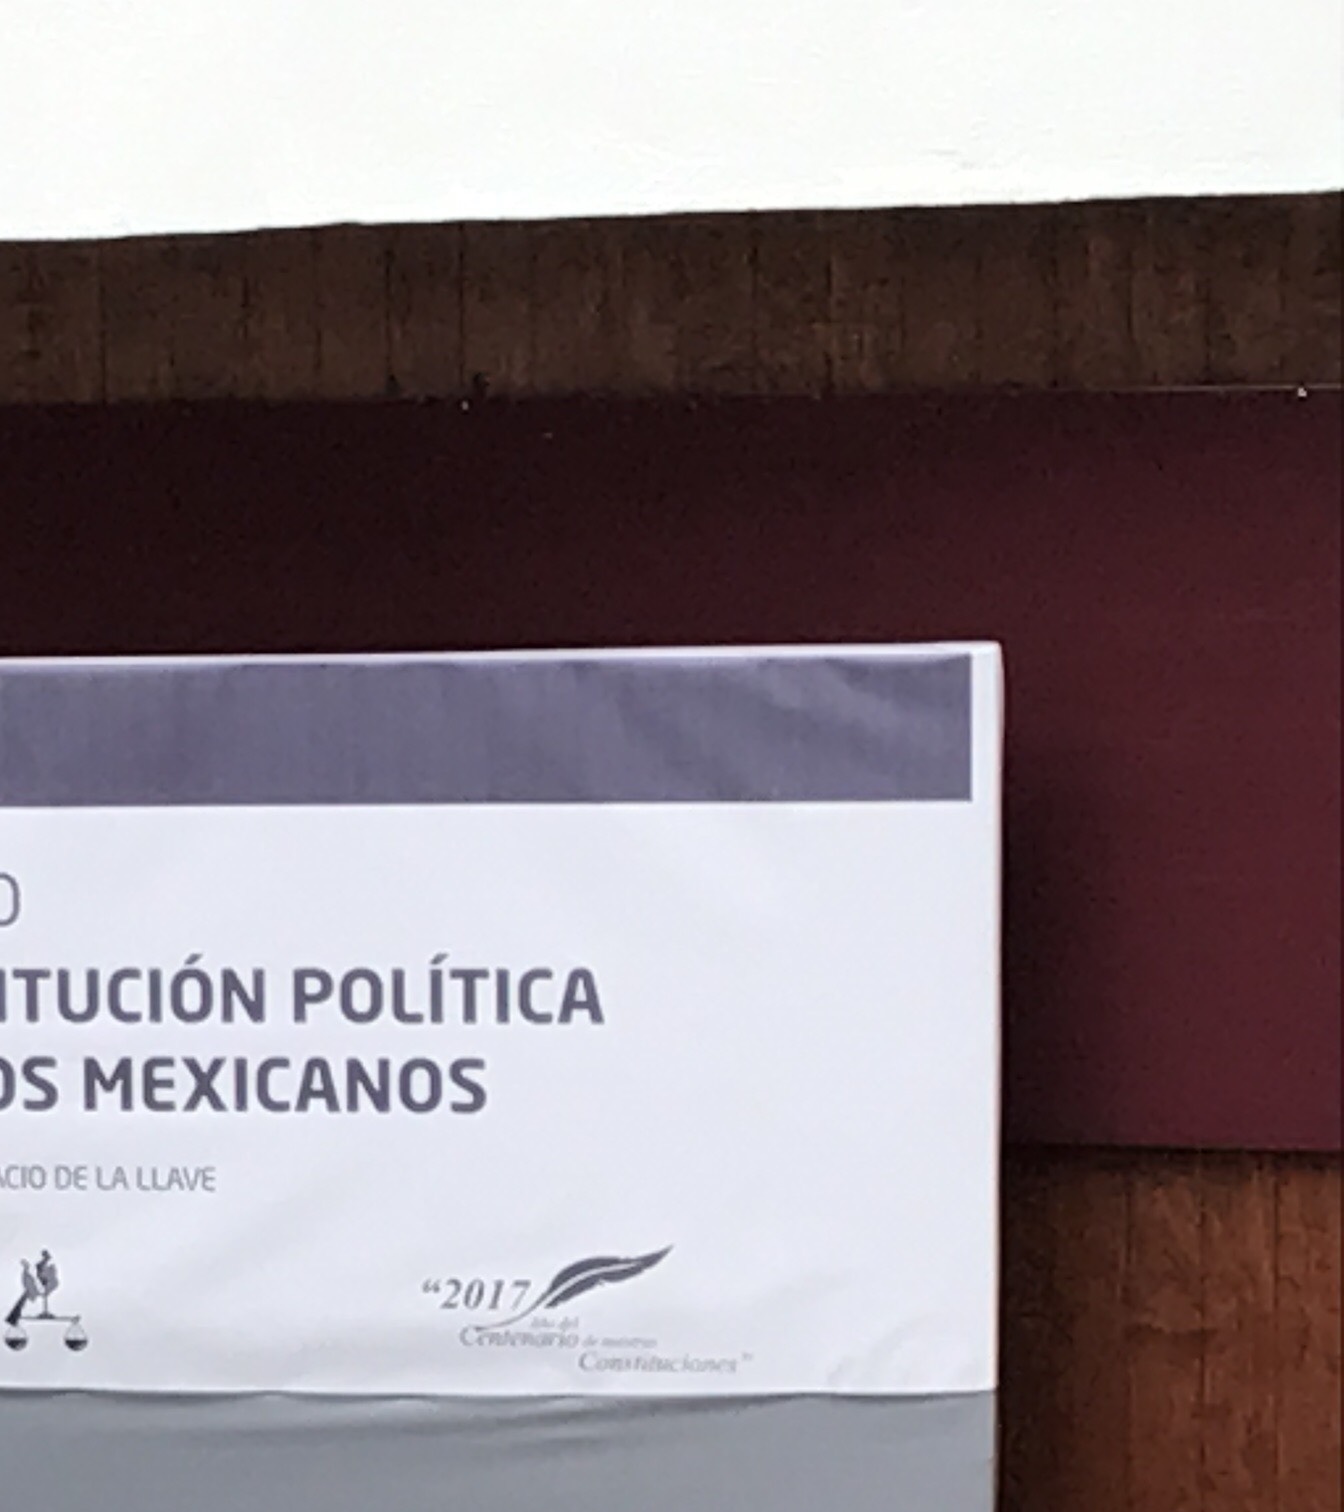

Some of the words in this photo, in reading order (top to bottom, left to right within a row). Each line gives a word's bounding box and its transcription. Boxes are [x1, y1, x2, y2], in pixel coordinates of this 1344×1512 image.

[292, 953, 605, 1025] POLÍTICA
[83, 1057, 487, 1115] MEXICANOS
[54, 1165, 88, 1191] DE
[96, 1166, 130, 1191] LA
[136, 1166, 216, 1192] LLAVE
[459, 1326, 580, 1348] Centenario
